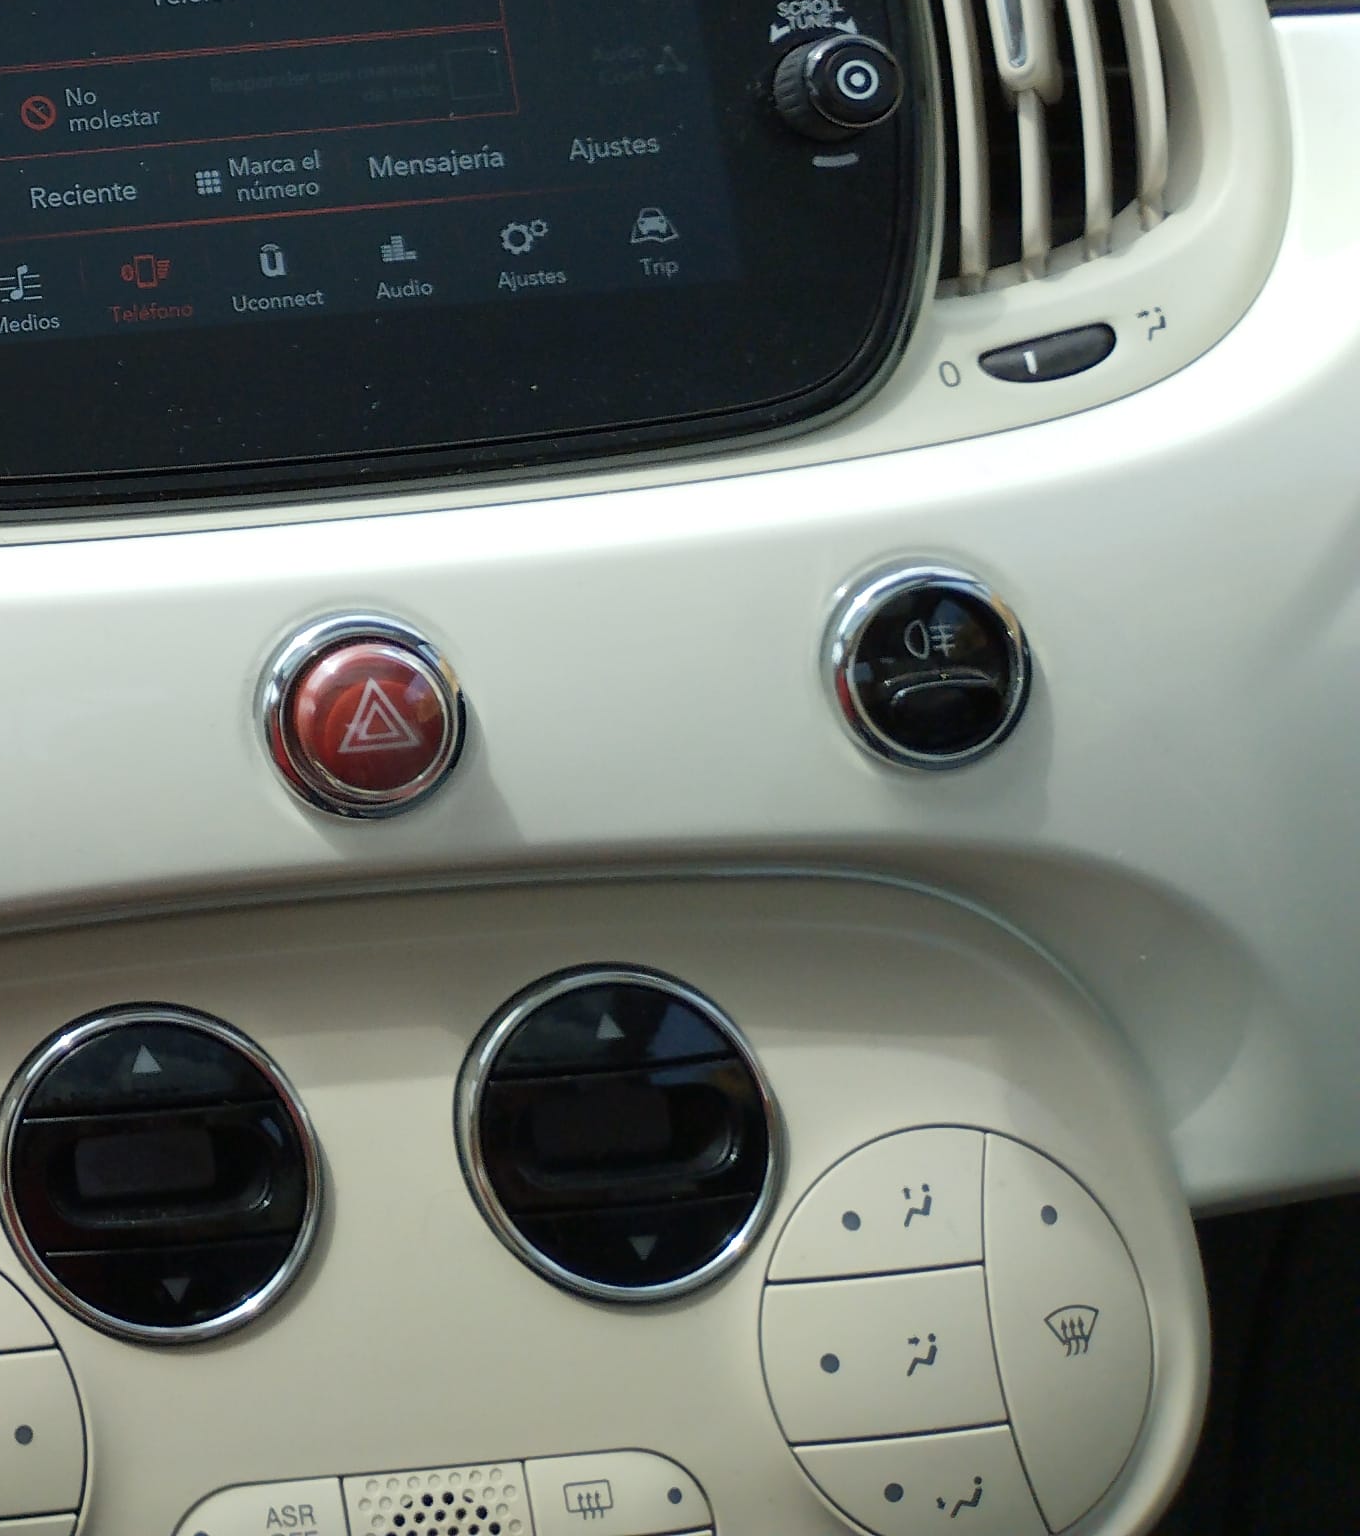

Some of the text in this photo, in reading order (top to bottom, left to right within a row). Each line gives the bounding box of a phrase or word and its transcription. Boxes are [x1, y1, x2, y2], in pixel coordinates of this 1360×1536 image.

[65, 88, 96, 108] No
[68, 108, 160, 132] molestar
[569, 132, 660, 162] Ajustes
[229, 150, 320, 177] Marca el
[369, 145, 505, 181] Mensajería
[30, 181, 137, 209] Reciente
[236, 177, 319, 202] número
[497, 267, 567, 291] Ajustes
[641, 256, 680, 279] Trip
[232, 289, 324, 312] Uconnect
[376, 279, 433, 299] Audio
[111, 300, 193, 324] Teléfono
[939, 361, 961, 387] 0
[266, 1503, 317, 1529] ASR
